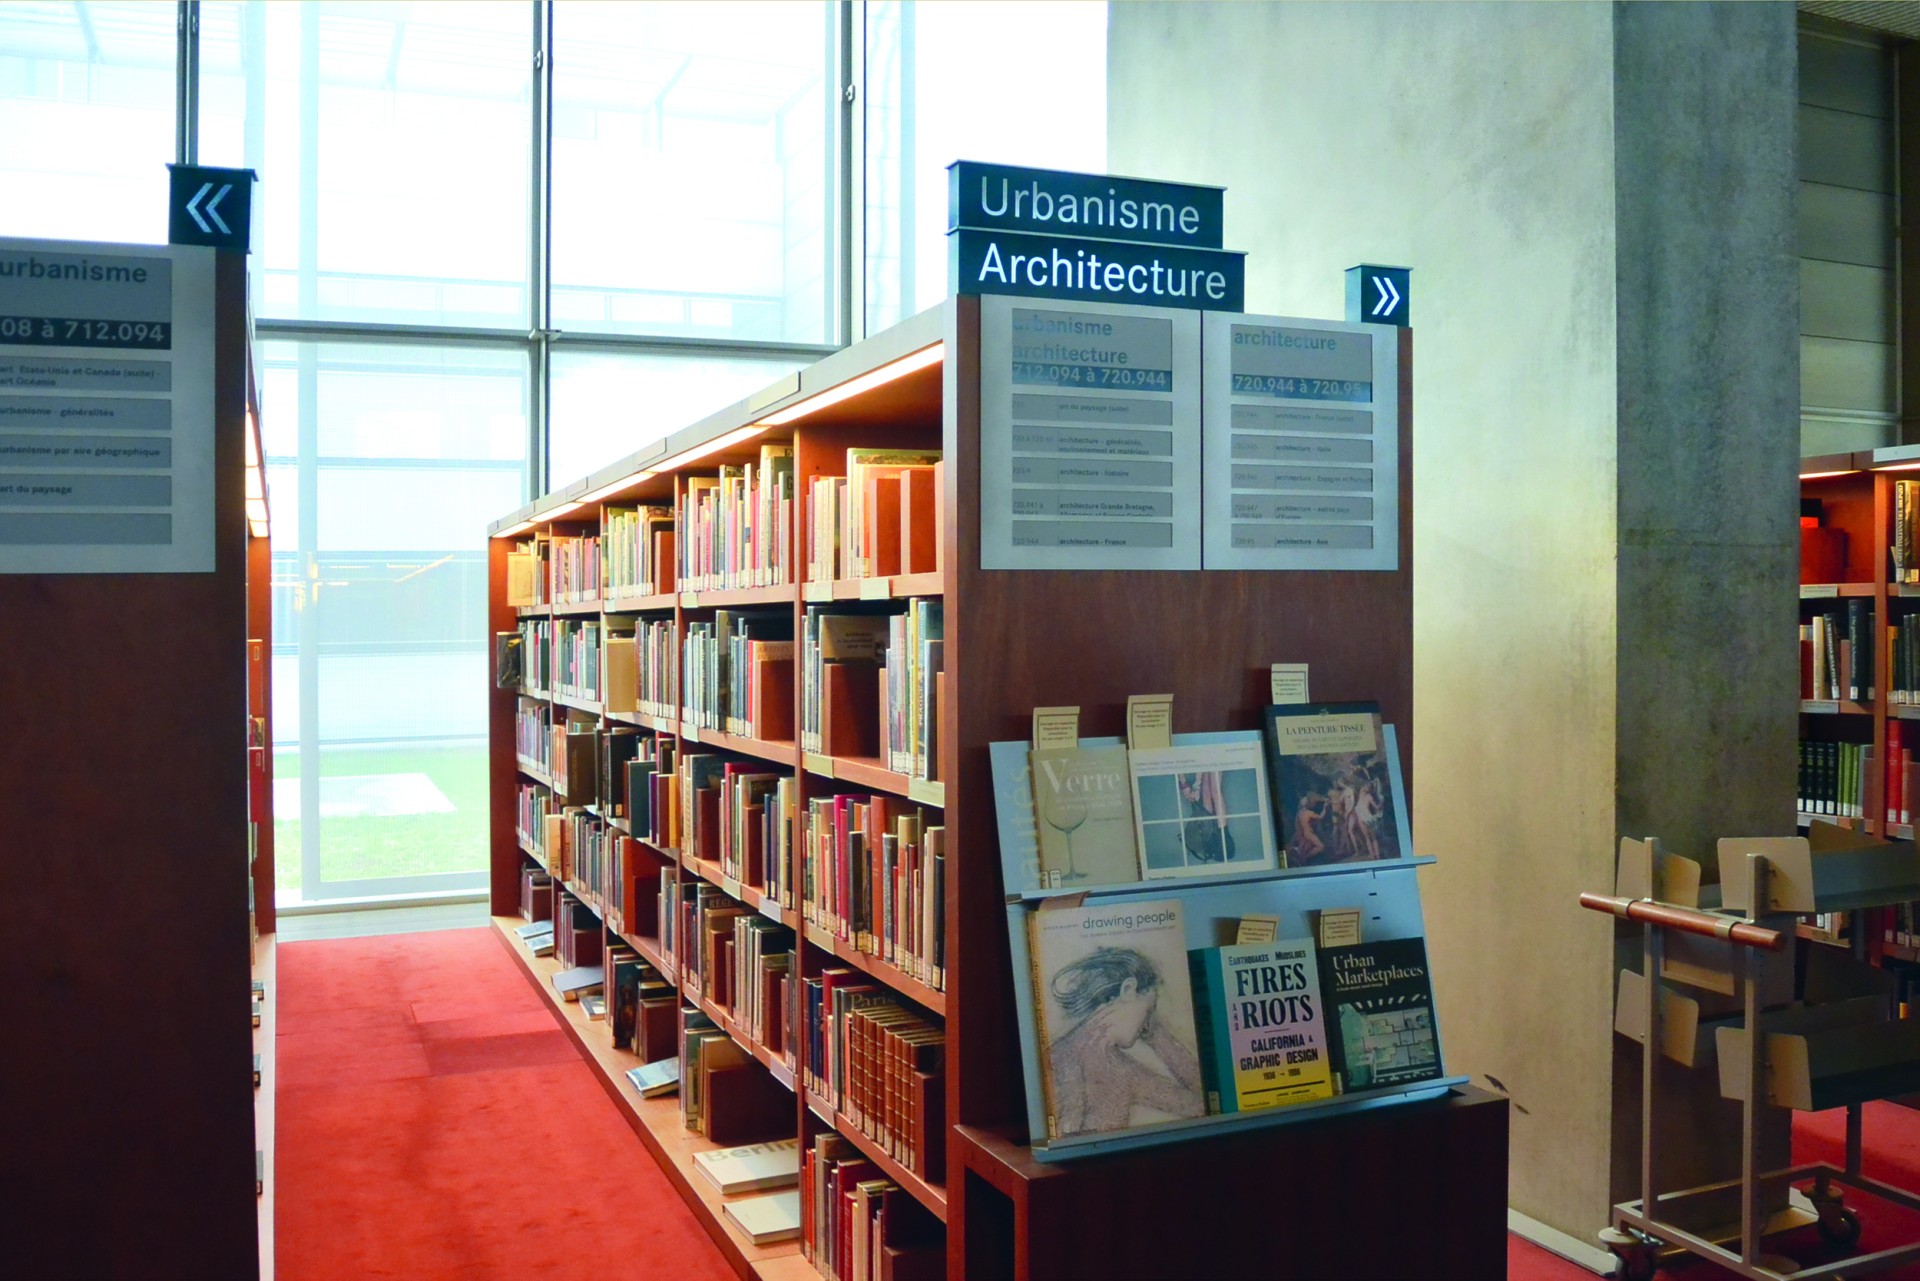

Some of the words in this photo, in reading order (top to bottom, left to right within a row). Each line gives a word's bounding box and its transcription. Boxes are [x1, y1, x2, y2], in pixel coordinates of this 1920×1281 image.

[981, 176, 1200, 234] Urbanisme
[0, 257, 148, 283] urbanisme
[978, 242, 1226, 300] Architecture
[41, 319, 54, 339] à
[65, 321, 164, 342] 712.094
[1012, 314, 1112, 336] urbanisme
[1234, 329, 1336, 350] architecture
[1012, 343, 1128, 365] architecture
[1086, 368, 1095, 382] à
[1102, 368, 1166, 387] 720.944
[1235, 375, 1294, 394] 720.944
[1300, 379, 1307, 393] à
[1059, 467, 1099, 476] architecture
[1059, 502, 1099, 510] architecture
[1059, 538, 1099, 546] architecture
[1039, 757, 1121, 794] Verre
[1082, 914, 1133, 929] drawing
[1136, 908, 1176, 927] people
[1332, 953, 1375, 971] Urban
[1235, 962, 1307, 997] FIRES
[1335, 964, 1424, 987] Marketplaces
[1241, 994, 1314, 1029] RIOTS
[1251, 1034, 1305, 1053] CALIFORNIA
[1240, 1053, 1280, 1071] GRAPHIC
[1287, 1048, 1319, 1064] DESIGN
